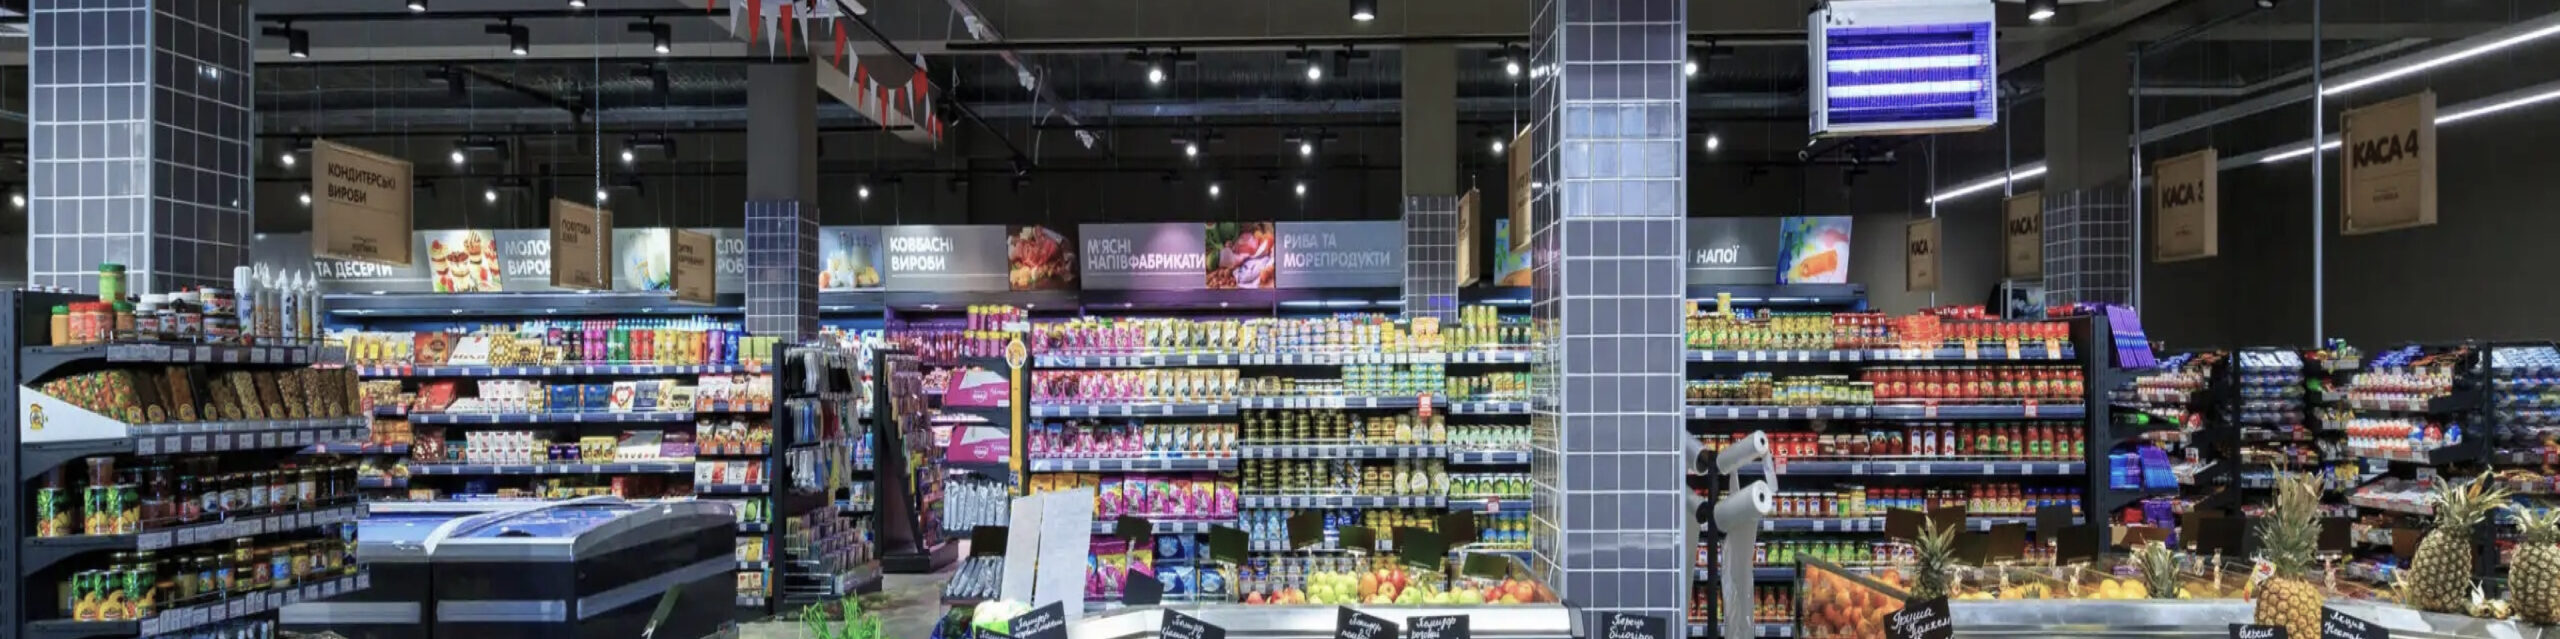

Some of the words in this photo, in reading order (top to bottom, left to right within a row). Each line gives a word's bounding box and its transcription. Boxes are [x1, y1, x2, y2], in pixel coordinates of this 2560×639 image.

[2353, 134, 2403, 170] КАСА
[2404, 128, 2419, 158] 4
[328, 163, 396, 190] КОНДИТЕРСЬКІ
[328, 183, 366, 205] ВИРОБИ
[2162, 182, 2196, 208] КАСА
[2010, 217, 2032, 235] КАСА
[889, 237, 953, 252] КОВБАСНІ
[1088, 239, 1131, 254] М'ЯСНІ
[1322, 232, 1337, 249] ТА
[1911, 238, 1928, 256] КАСА
[892, 255, 945, 271] ВИРОБИ
[1088, 254, 1206, 269] НАПІВФАБРИКАТИ
[1284, 251, 1390, 268] МОРЕПРОДУКТИ
[1697, 245, 1740, 264] НАПОЇ
[315, 261, 332, 277] ТА
[1891, 607, 1935, 635] Груша
